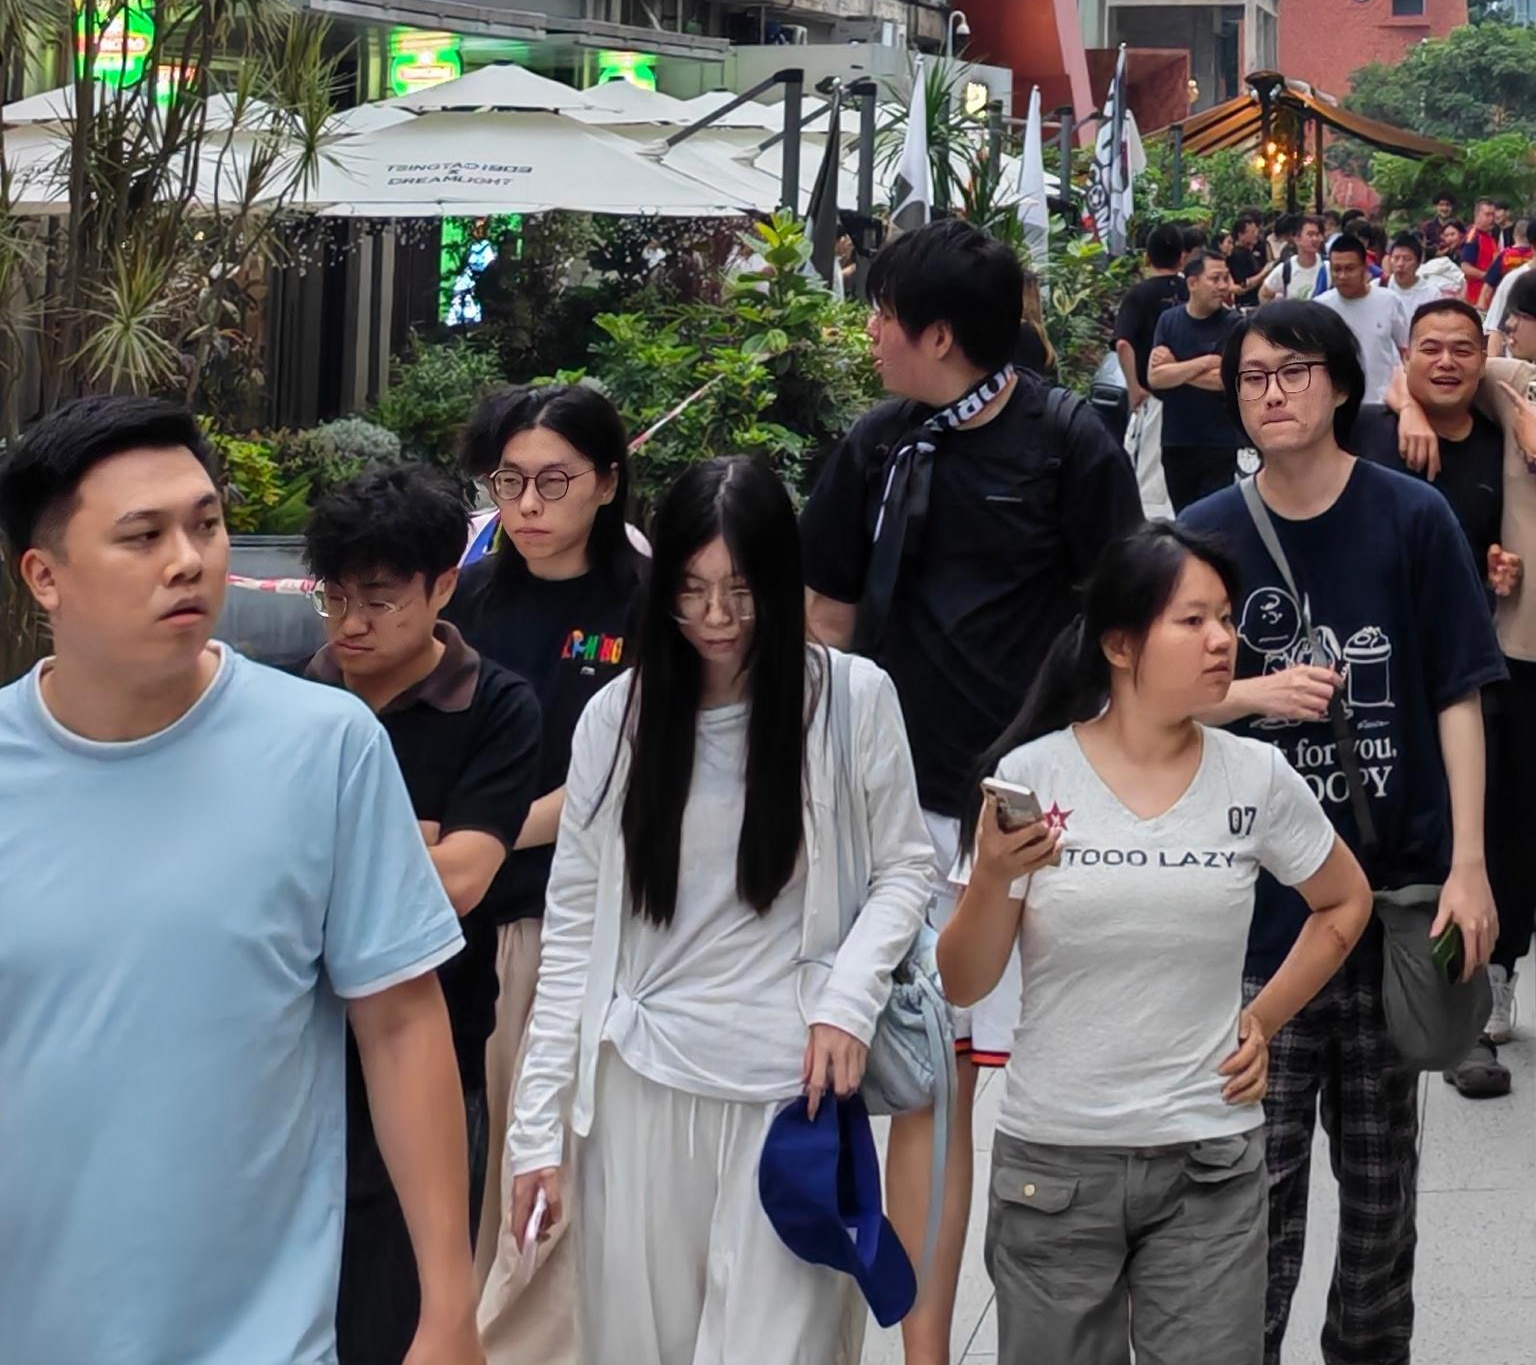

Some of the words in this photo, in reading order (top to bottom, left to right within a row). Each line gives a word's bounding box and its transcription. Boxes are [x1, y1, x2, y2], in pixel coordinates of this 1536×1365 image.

[1295, 738, 1336, 768] for
[1227, 806, 1258, 836] 07
[1065, 848, 1148, 867] TOOO
[1159, 850, 1237, 869] LAZY
